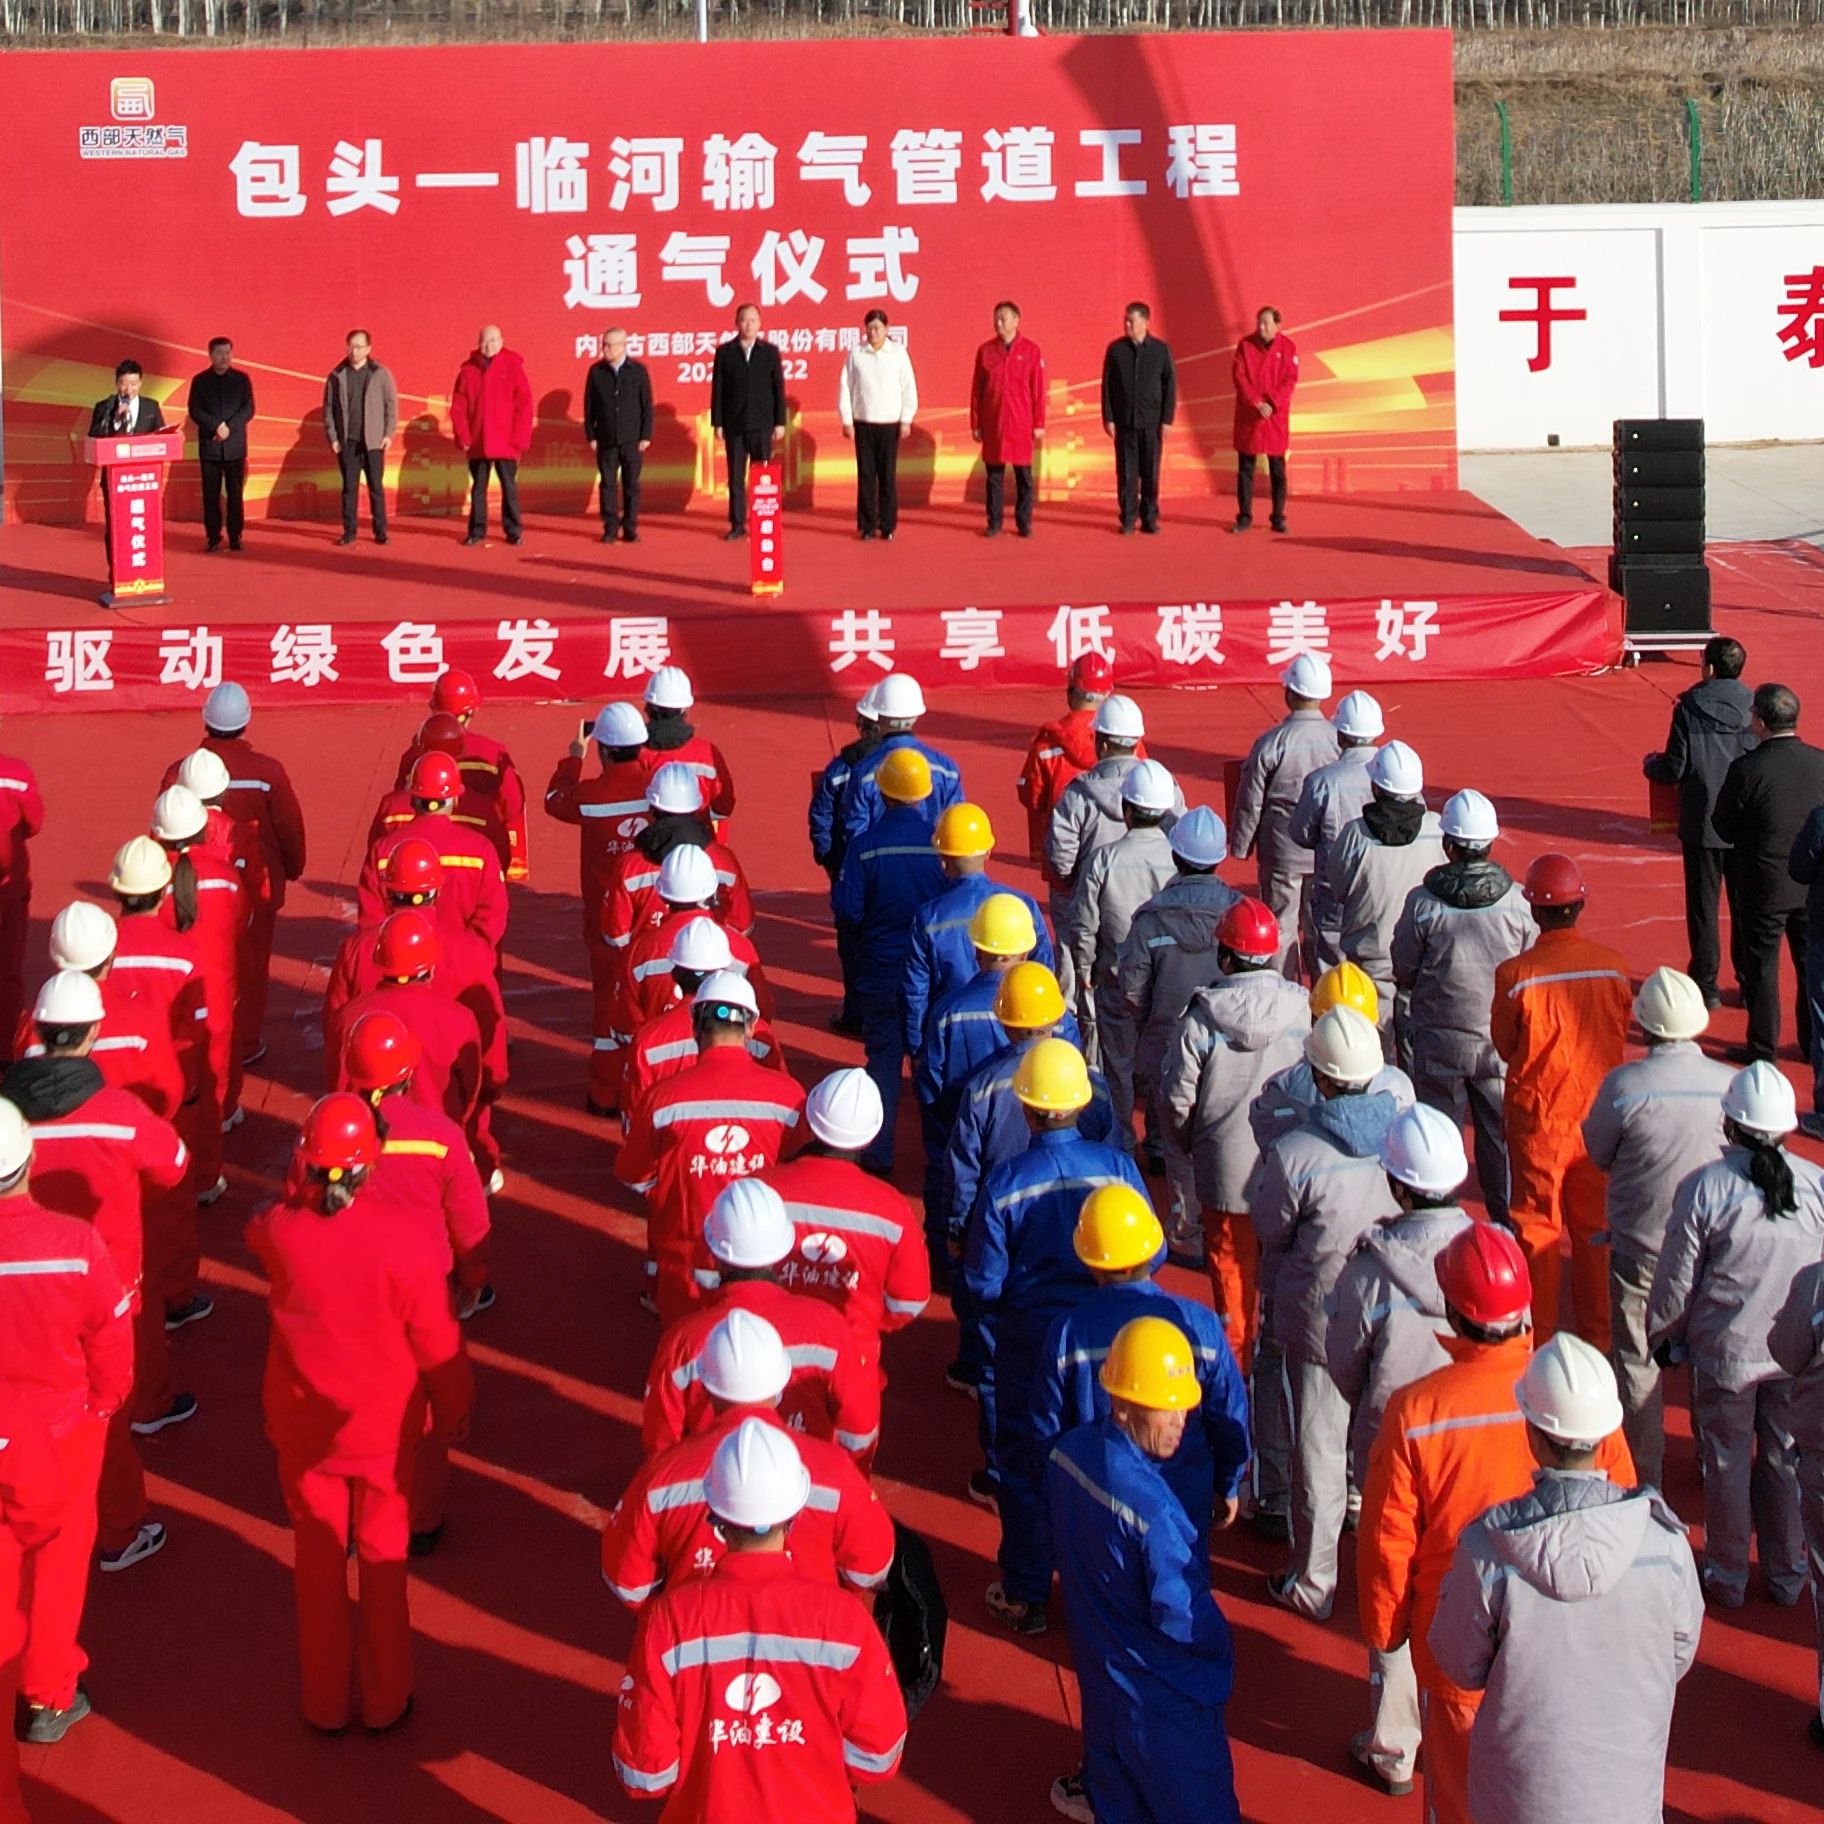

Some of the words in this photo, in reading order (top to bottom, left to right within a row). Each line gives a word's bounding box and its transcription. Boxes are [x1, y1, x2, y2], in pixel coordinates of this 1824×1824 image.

[80, 125, 187, 147] 西部天然气
[562, 226, 919, 312] 通气仪式
[45, 616, 670, 693] 驱动绿色发展
[830, 601, 1440, 672] 共享低碳美好
[709, 1712, 805, 1755] 华油建设
